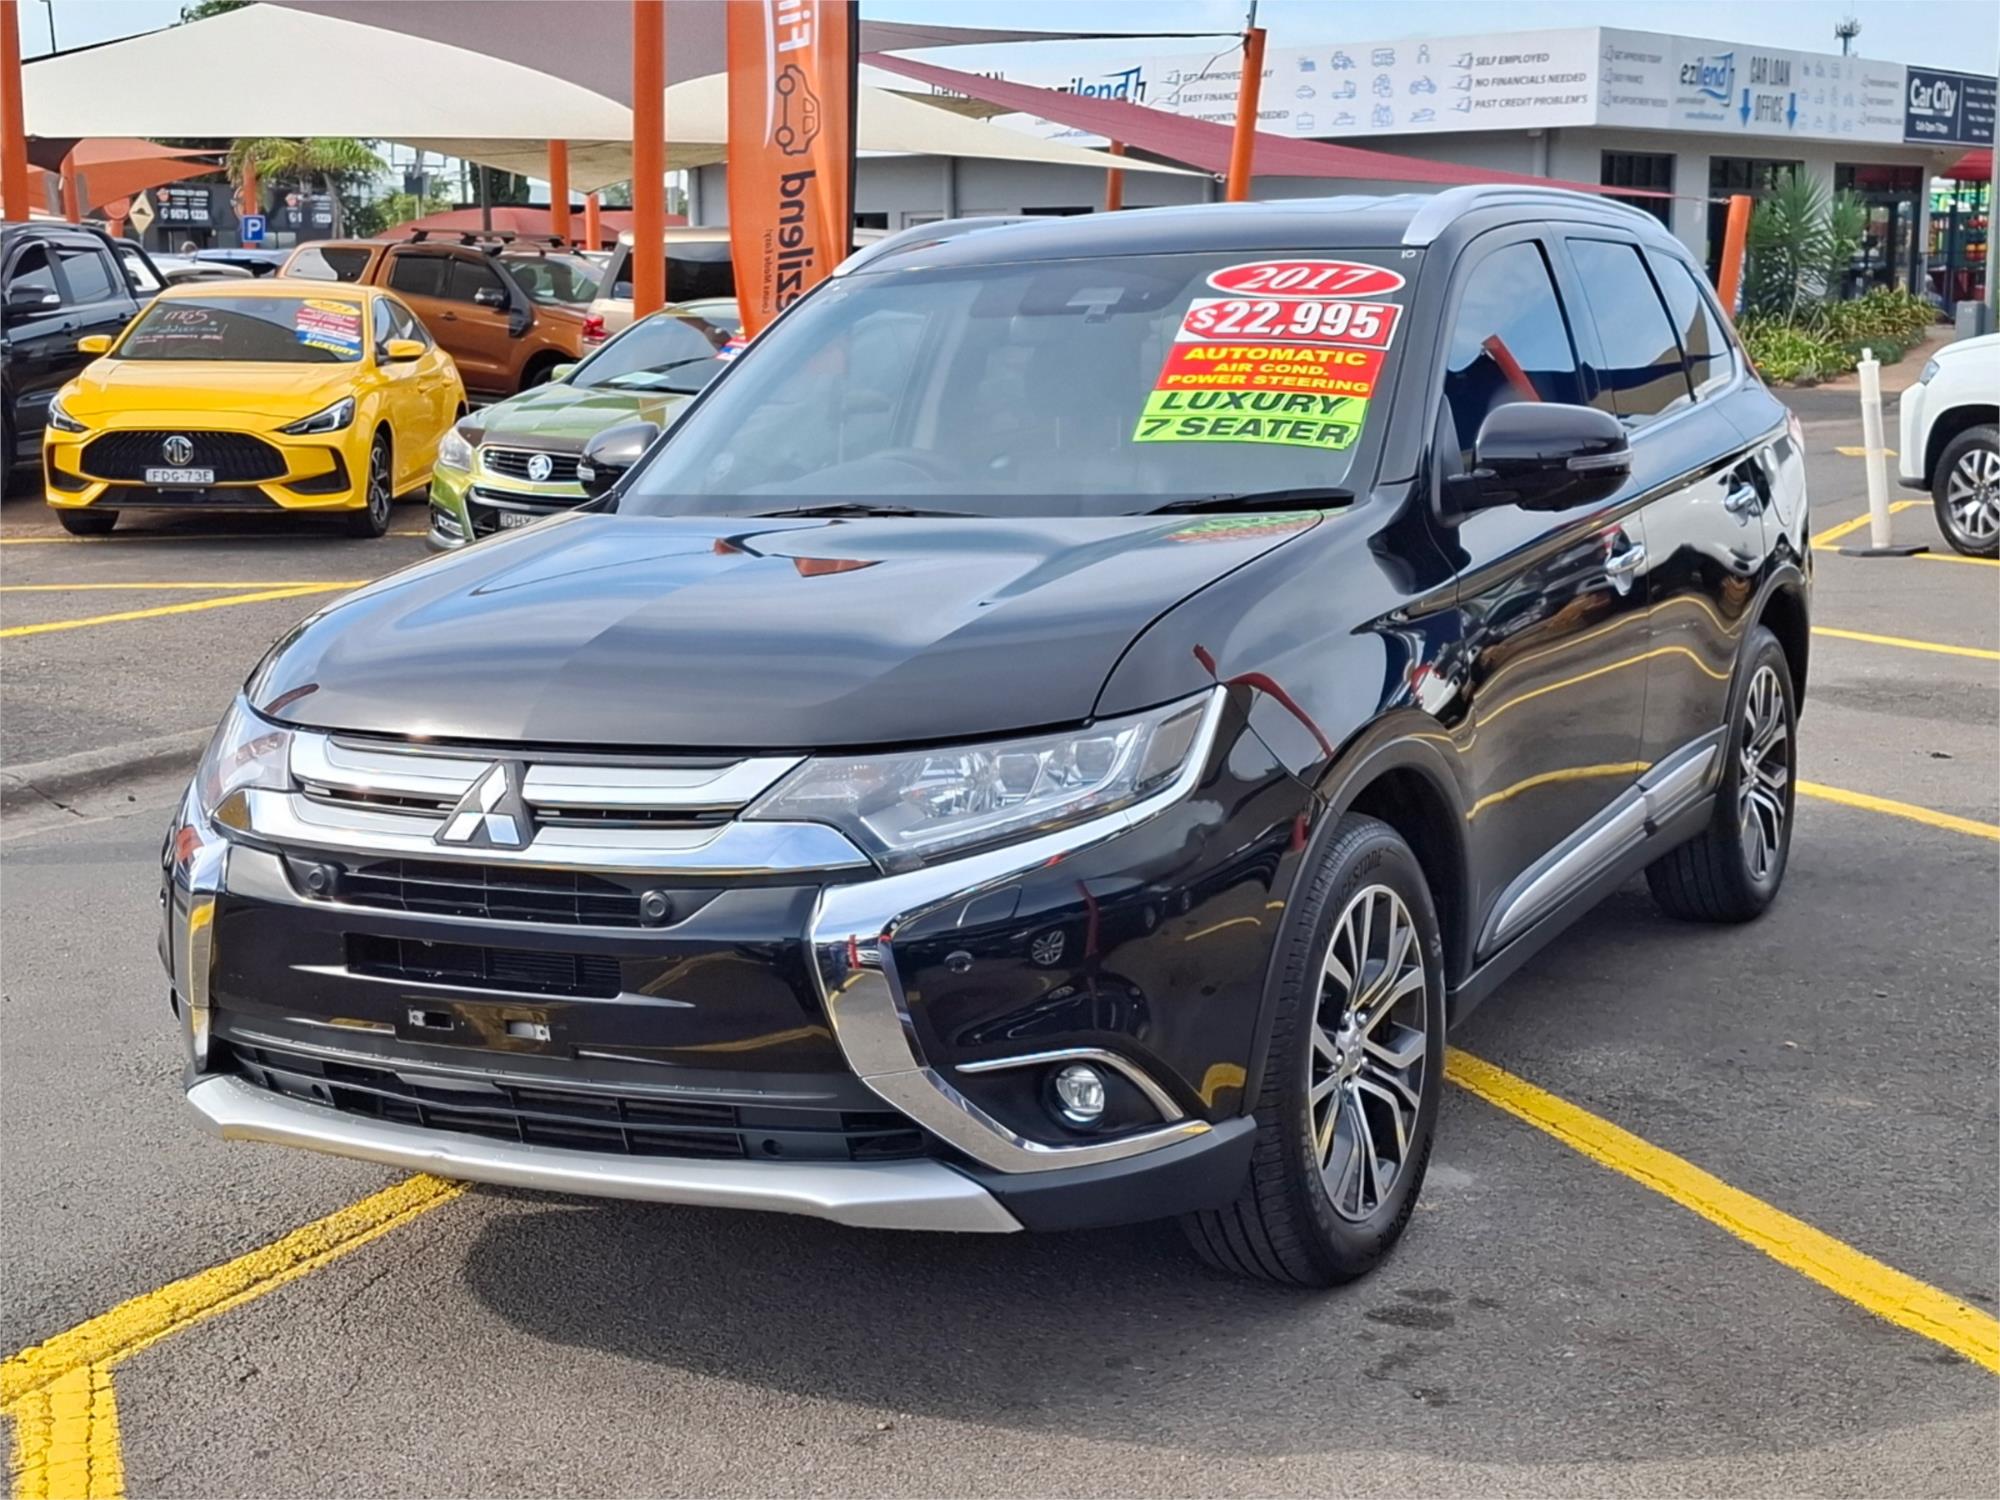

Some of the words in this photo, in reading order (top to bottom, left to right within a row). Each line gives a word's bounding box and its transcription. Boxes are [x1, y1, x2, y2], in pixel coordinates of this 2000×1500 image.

[1474, 56, 1497, 66] SELF
[1498, 53, 1550, 65] EMPLOYED
[1474, 78, 1489, 88] NO
[1491, 75, 1545, 87] FINANCIALS
[1547, 73, 1587, 84] NEEDED
[1679, 56, 1727, 86] ezilend
[1750, 56, 1768, 84] CAR
[1769, 58, 1791, 86] LOAN
[1474, 99, 1498, 109] PAST
[1498, 97, 1532, 108] CREDIT
[1910, 78, 1933, 108] Car
[1933, 80, 1957, 117] City
[247, 219, 261, 238] P
[1232, 266, 1378, 291] 2017
[1191, 301, 1385, 339] $22,995
[1184, 347, 1368, 366] AUTOMATIC
[1213, 363, 1253, 373] AIR
[1259, 364, 1329, 376] COND.
[1166, 375, 1246, 385] POWER
[1252, 375, 1370, 393] STEERING
[1160, 392, 1350, 415] LUXURY
[1141, 418, 1171, 437] 7
[1175, 417, 1351, 444] SEATER
